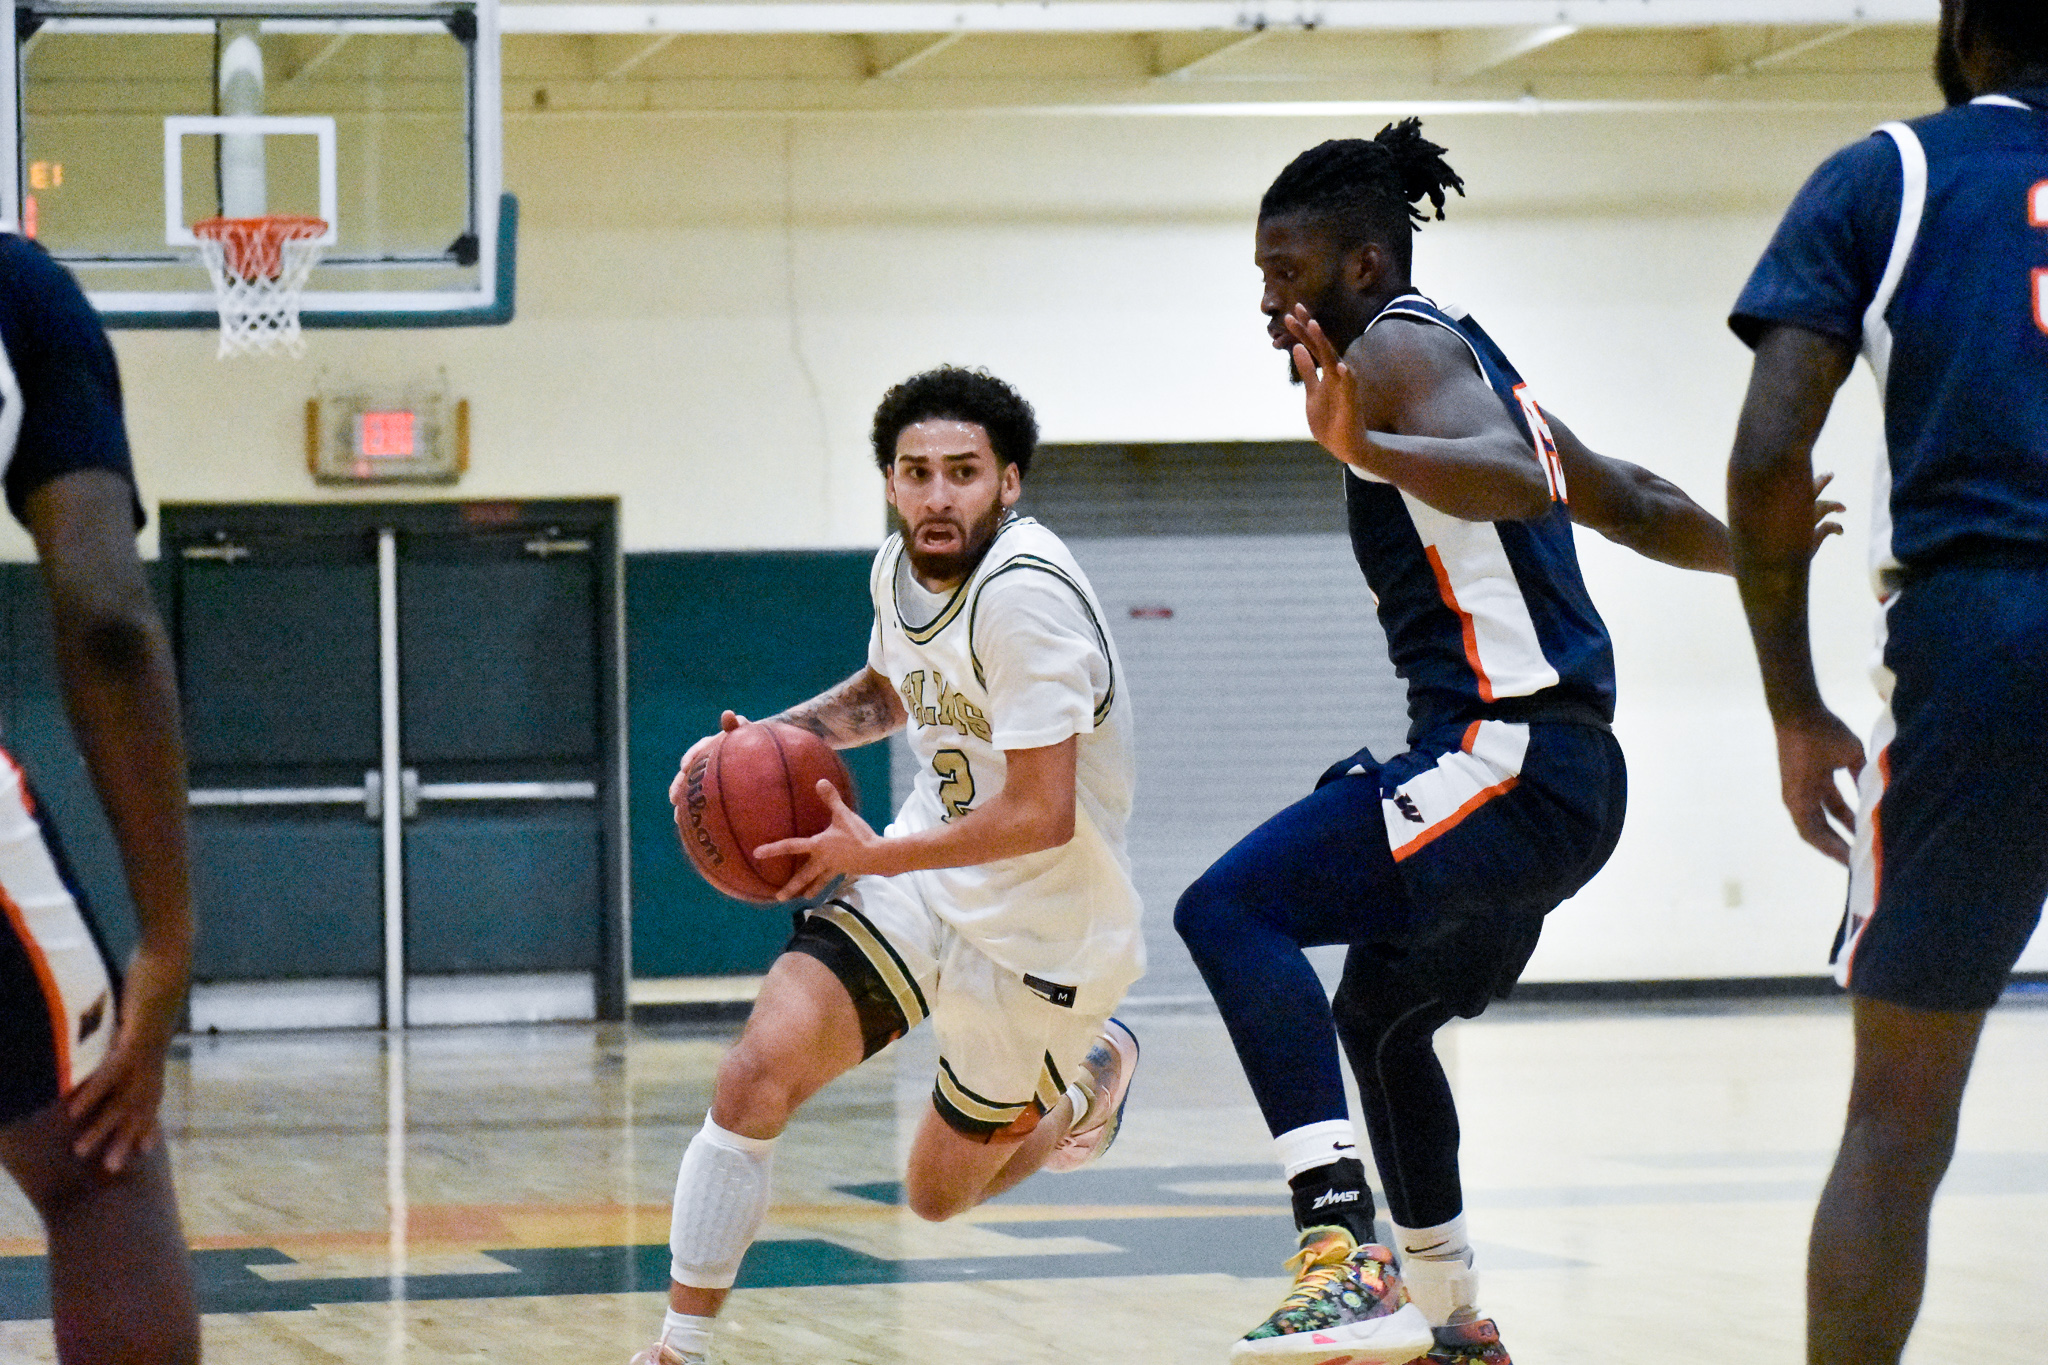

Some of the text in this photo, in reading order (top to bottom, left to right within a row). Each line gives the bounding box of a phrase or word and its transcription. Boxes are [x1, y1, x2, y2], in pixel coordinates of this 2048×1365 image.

[687, 752, 726, 867] Wilson
[931, 748, 976, 824] 2
[1057, 992, 1069, 1003] M
[1312, 1187, 1361, 1210] ZAMST
